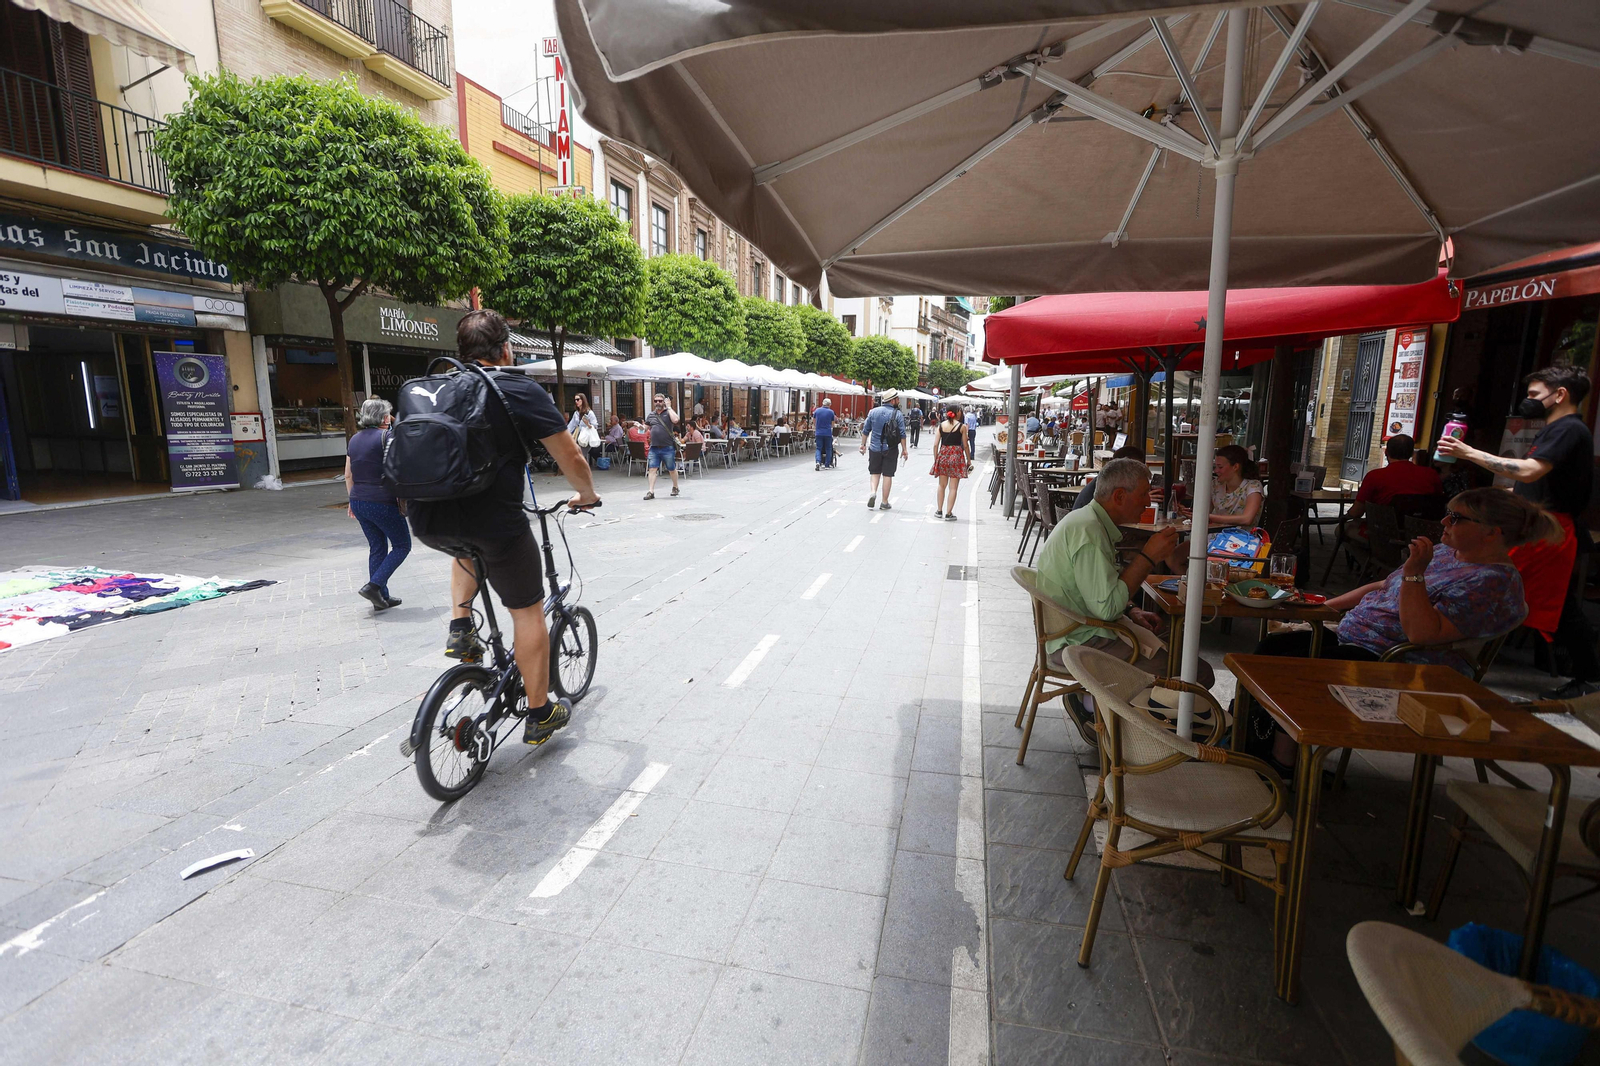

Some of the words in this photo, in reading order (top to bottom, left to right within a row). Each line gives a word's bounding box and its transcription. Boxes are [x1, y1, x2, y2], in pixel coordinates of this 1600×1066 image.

[555, 56, 570, 185] MIAMI
[64, 229, 121, 260] San
[134, 242, 228, 279] Jacinto
[13, 275, 20, 285] y
[21, 286, 39, 297] del
[1464, 279, 1557, 308] PAPELÓN
[380, 307, 406, 319] MARÍA
[381, 316, 439, 336] LIMONES
